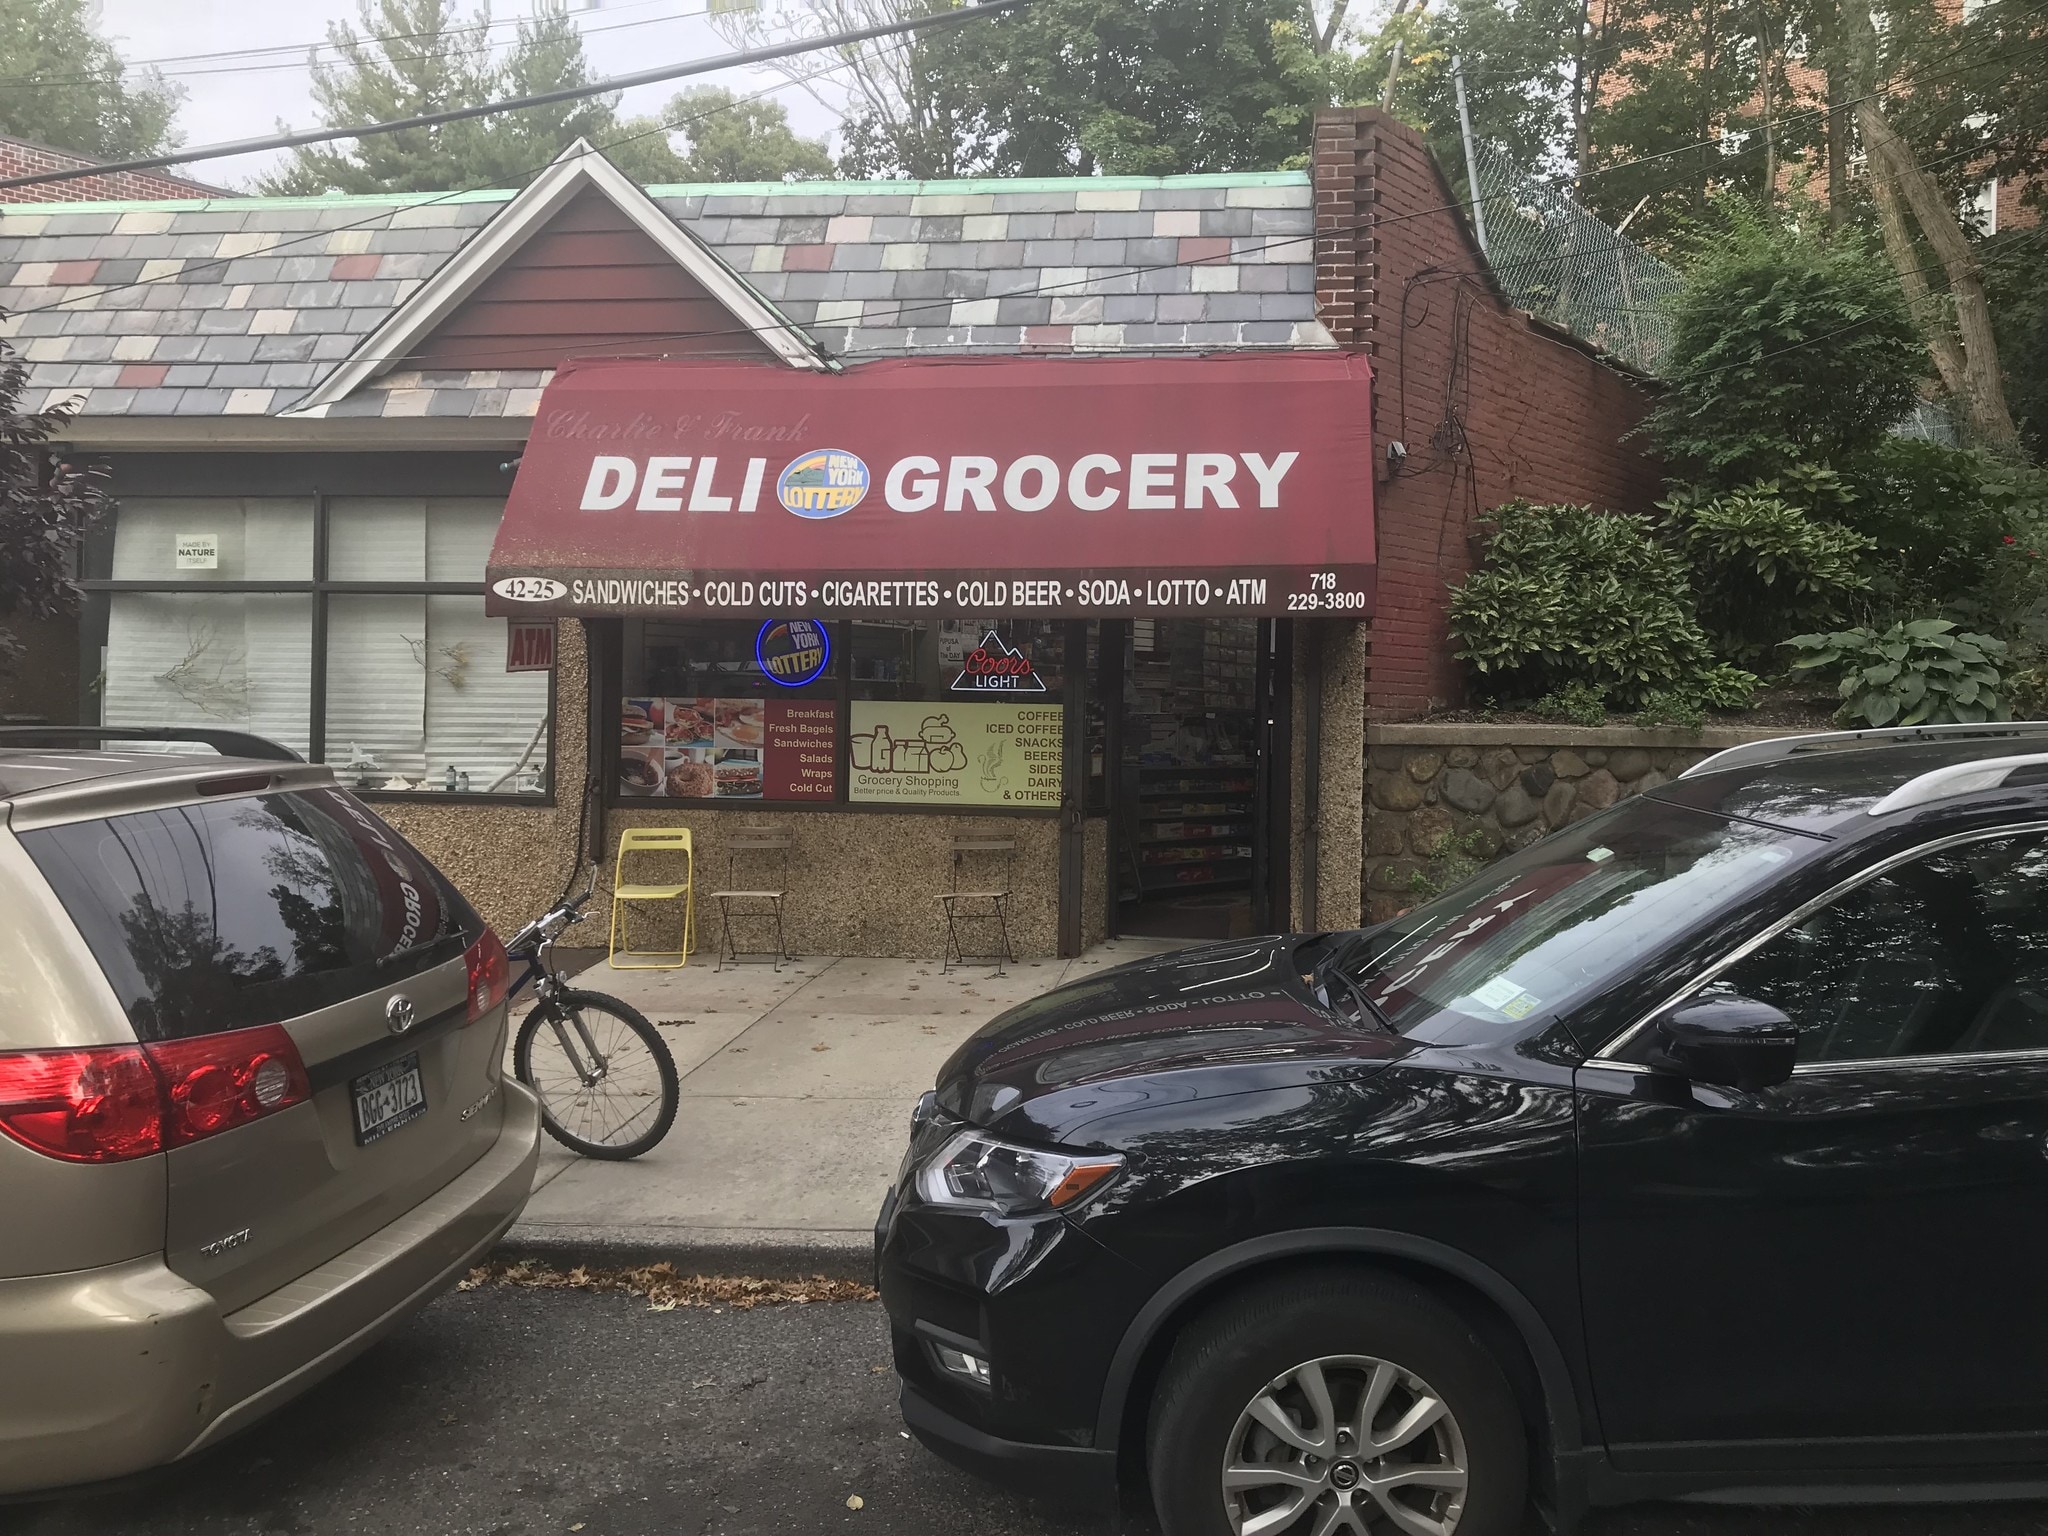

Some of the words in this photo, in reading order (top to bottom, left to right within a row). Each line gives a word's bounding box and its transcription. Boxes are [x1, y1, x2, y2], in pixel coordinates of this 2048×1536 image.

[546, 409, 661, 440] Charlie
[673, 414, 700, 440] &
[704, 410, 811, 441] Frank
[828, 454, 858, 468] NEW
[580, 456, 767, 512] DELI
[884, 452, 1300, 512] GROCERY
[829, 467, 863, 486] YORK
[783, 486, 864, 509] LOTTERY
[178, 548, 215, 557] NATURE
[1310, 573, 1337, 590] 718
[505, 579, 554, 599] 42-25
[572, 580, 689, 605] SANDWICHES
[704, 581, 754, 606] COLD
[759, 581, 807, 606] CUTS
[822, 581, 939, 606] CIGARETTES
[956, 581, 1007, 607] COLD
[1012, 580, 1062, 606] BEER
[1078, 580, 1131, 606] SODA
[1147, 579, 1209, 606] LOTTO
[1226, 578, 1267, 605] ATM
[1287, 592, 1366, 611] 229-3800
[789, 621, 812, 634] NEW
[510, 628, 552, 666] ATM
[792, 632, 820, 650] YORK
[767, 647, 823, 675] LOTTERY
[965, 648, 1034, 675] Coors
[976, 675, 1019, 688] LIGHT
[787, 709, 834, 719] Breakfast
[1017, 711, 1063, 721] COFFEE
[769, 723, 797, 733] Fresh
[800, 724, 834, 735] Bagels
[986, 723, 1014, 734] ICED
[1017, 724, 1063, 735] COFFEE
[774, 738, 833, 748] Sandwiches
[1015, 738, 1063, 748] SNACKS
[800, 753, 833, 763] Salads
[1024, 751, 1063, 761] BEERS
[801, 768, 833, 780] Wraps
[1029, 764, 1063, 775] SIDES
[789, 783, 813, 792] Cold
[815, 784, 833, 793] Cut
[858, 774, 903, 788] Grocery
[905, 775, 959, 789] Shopping
[1028, 778, 1063, 788] DAIRY
[876, 788, 894, 796] price
[902, 788, 927, 797] Quality
[1003, 790, 1011, 800] &
[1014, 790, 1063, 801] OTHERS
